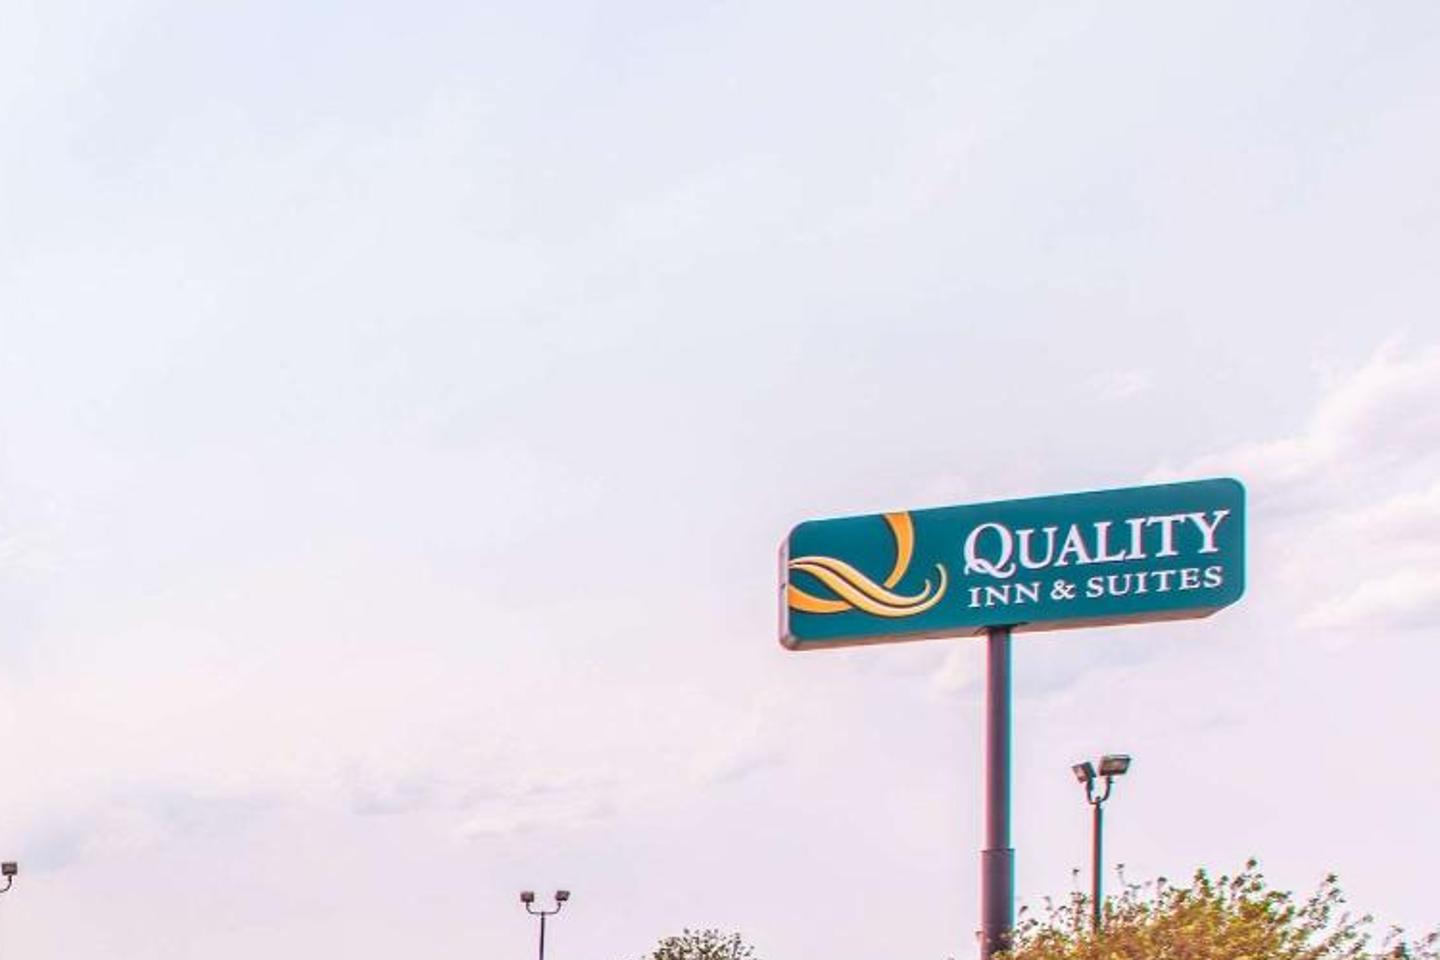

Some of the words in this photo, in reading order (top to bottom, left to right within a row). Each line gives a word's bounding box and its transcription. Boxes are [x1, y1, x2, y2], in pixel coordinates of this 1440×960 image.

[964, 510, 1230, 578] QUALITY
[968, 583, 1039, 608] INN
[1050, 579, 1075, 601] &
[1085, 566, 1224, 598] SUITES
